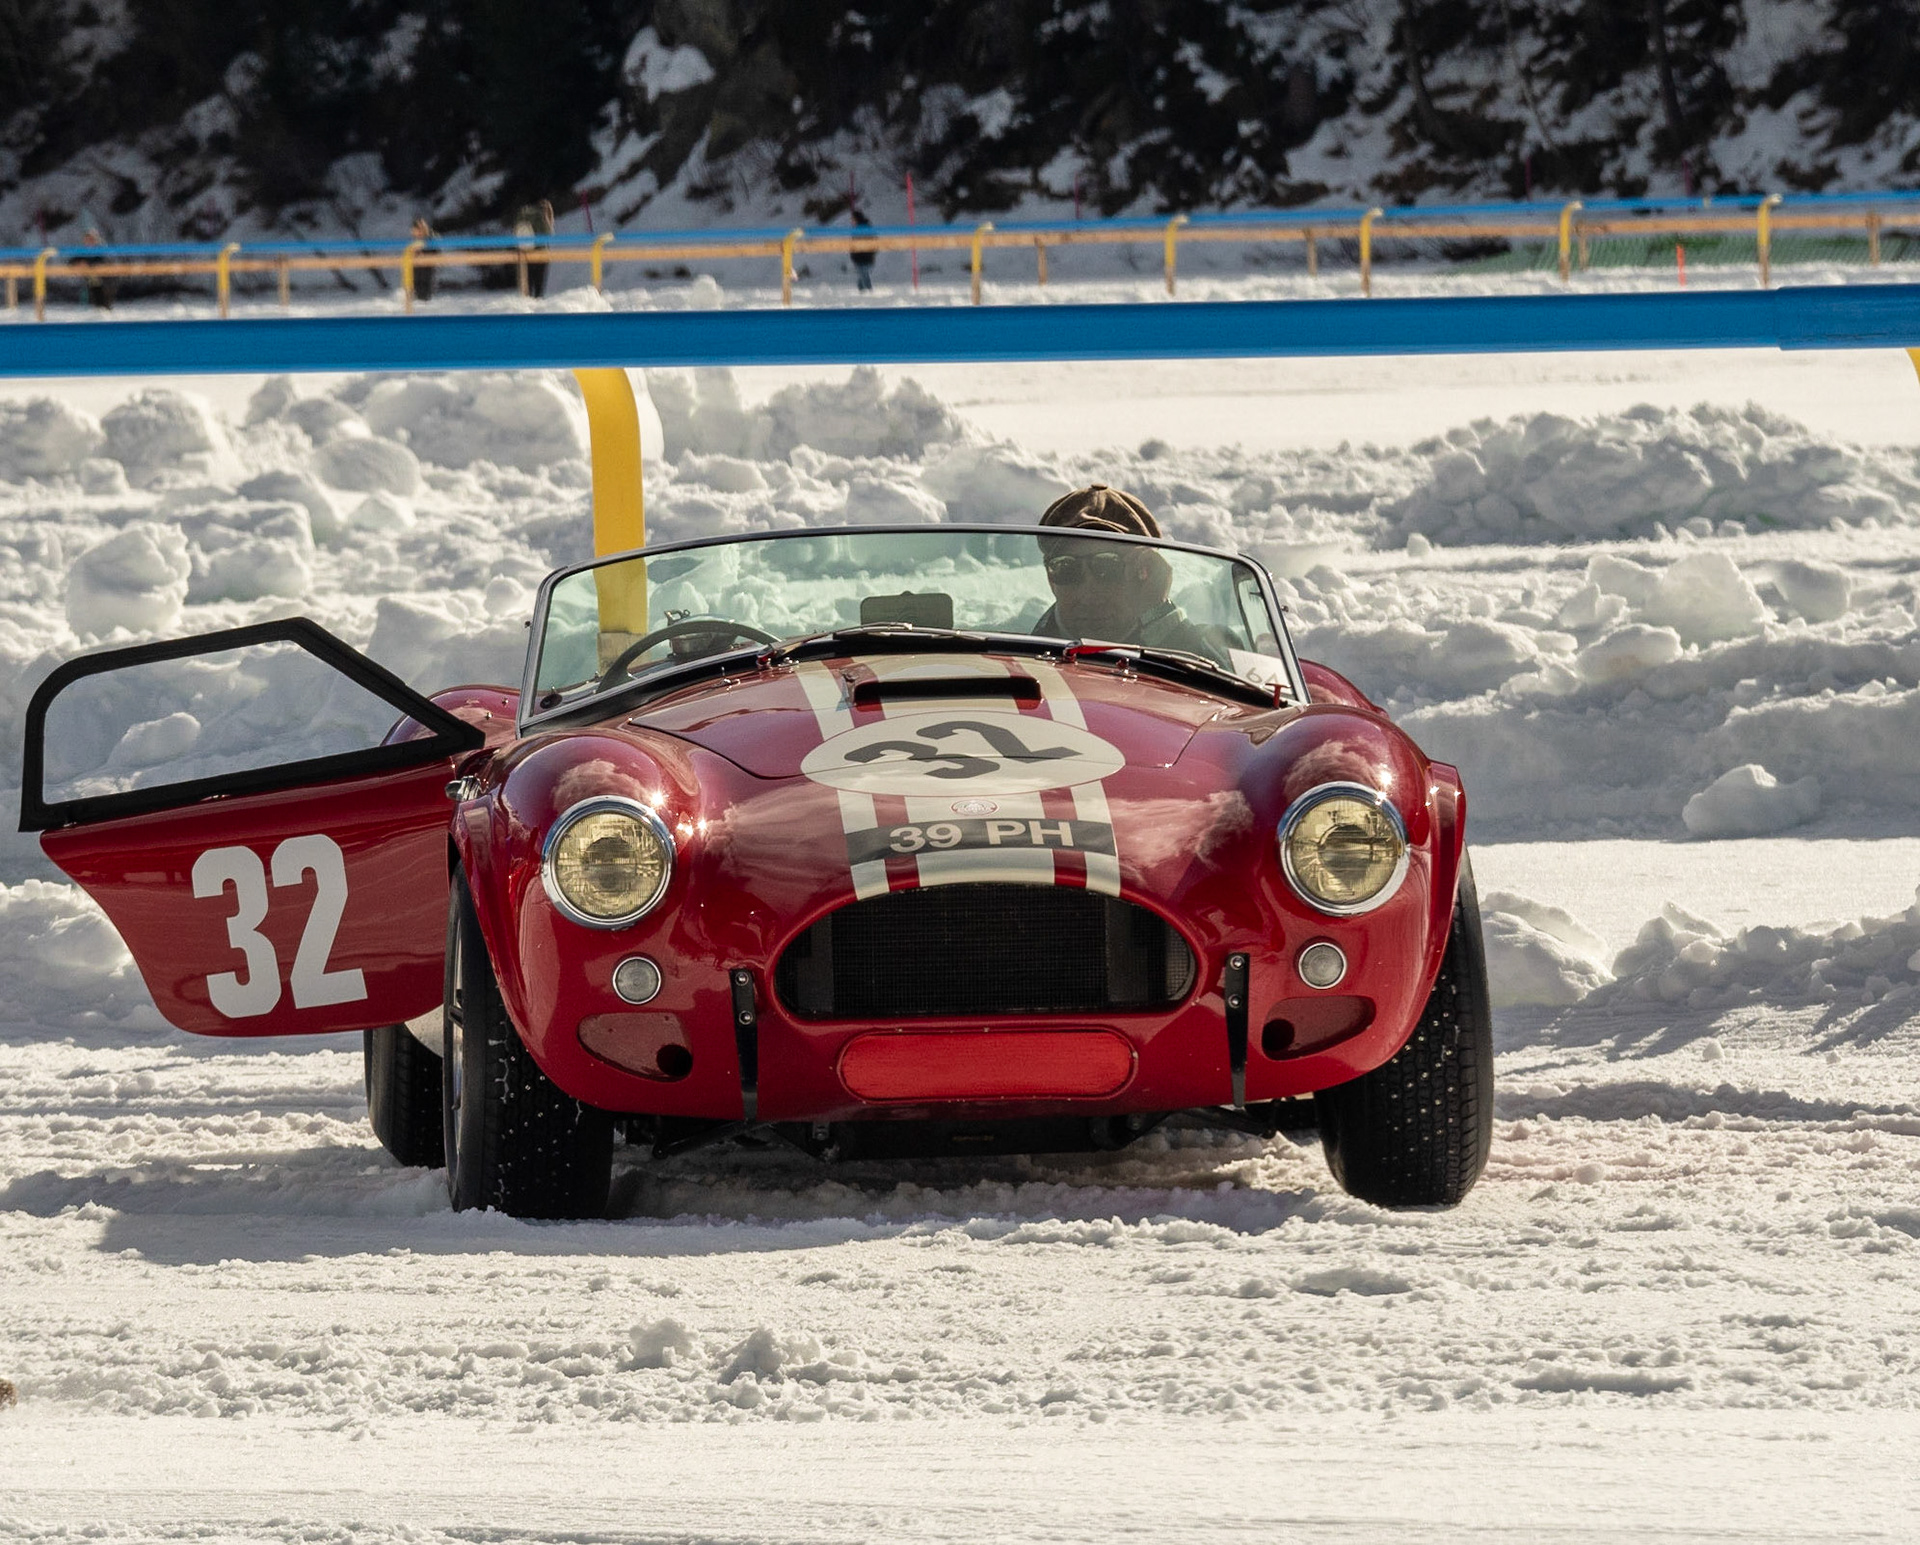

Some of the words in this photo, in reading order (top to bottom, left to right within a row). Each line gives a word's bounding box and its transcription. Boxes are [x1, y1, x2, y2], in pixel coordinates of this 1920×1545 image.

[844, 720, 1084, 780] 32
[889, 823, 963, 854] 39
[985, 820, 1075, 848] PH
[191, 833, 368, 1019] 32
